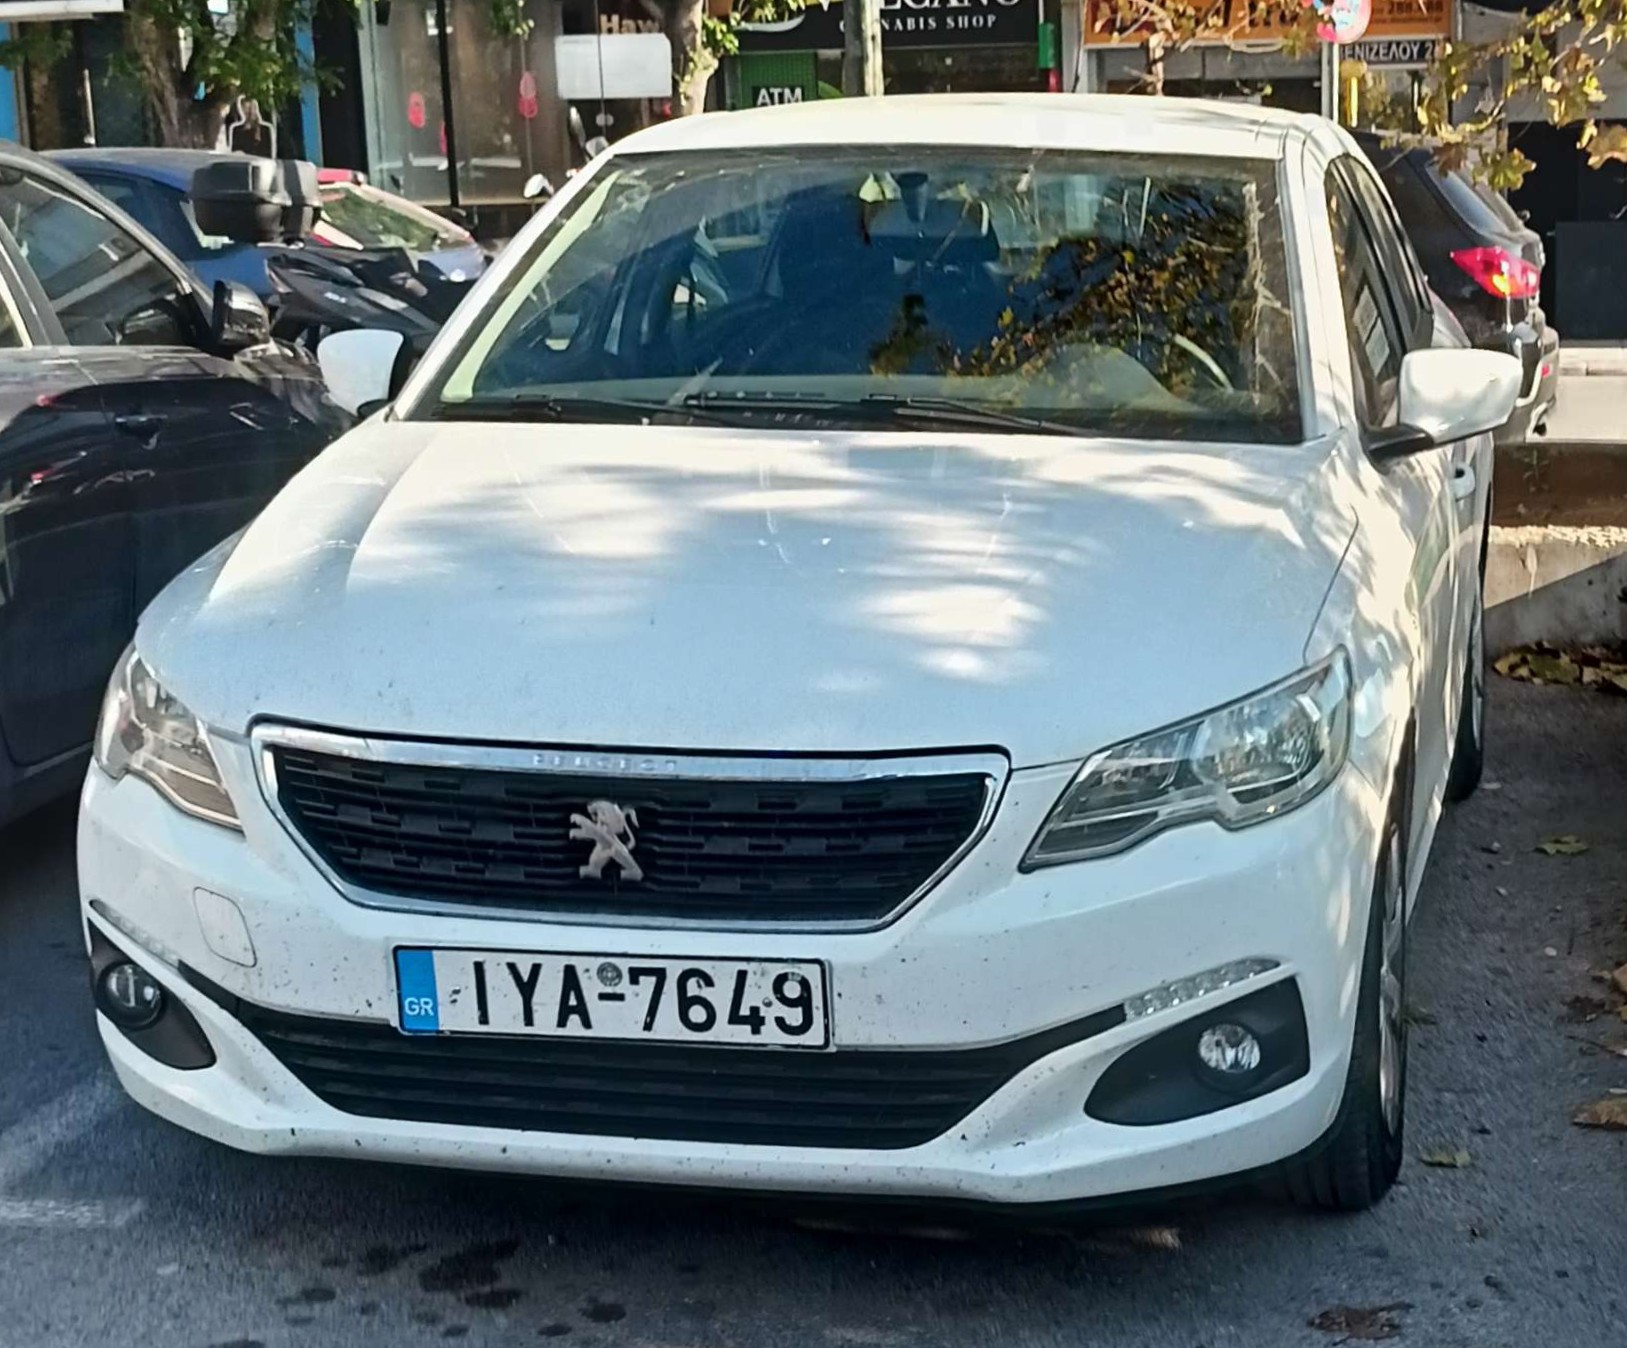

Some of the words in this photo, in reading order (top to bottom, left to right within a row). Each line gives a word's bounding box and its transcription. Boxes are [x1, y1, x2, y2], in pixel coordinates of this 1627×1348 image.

[839, 16, 938, 33] NABIS
[945, 14, 997, 30] SHOP
[757, 87, 802, 106] ATM
[404, 997, 435, 1016] GR
[473, 960, 815, 1036] IYA-7649
